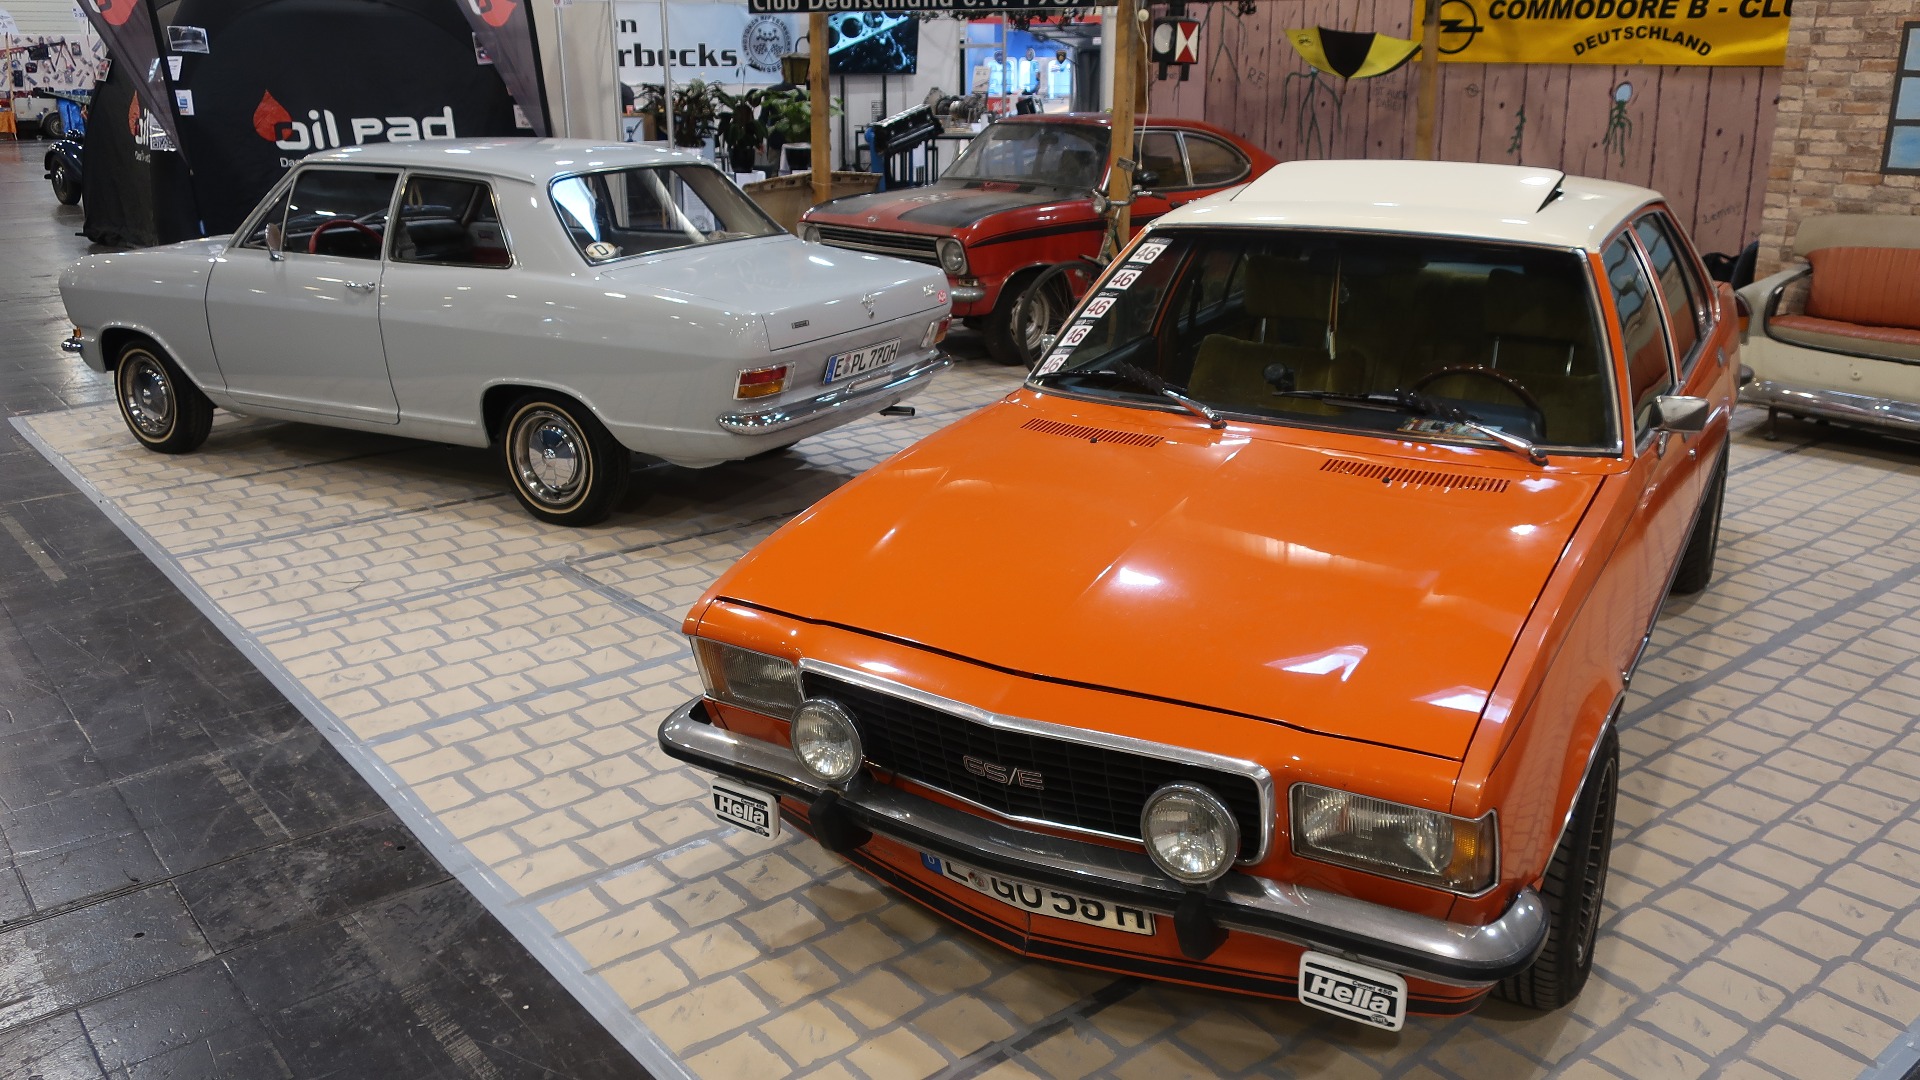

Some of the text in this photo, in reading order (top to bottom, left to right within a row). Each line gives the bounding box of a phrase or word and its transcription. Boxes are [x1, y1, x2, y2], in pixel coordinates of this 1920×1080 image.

[1489, 0, 1679, 19] COMMODORE
[1687, 0, 1708, 18] B
[1573, 25, 1712, 56] DEUTSCHLAND
[274, 105, 456, 150] oil pad
[594, 244, 608, 255] D
[1134, 245, 1162, 261] 46
[1111, 271, 1136, 287] 46
[1086, 299, 1111, 316] 46
[1066, 327, 1087, 344] 46
[834, 343, 898, 377] E PL 770H
[963, 755, 1044, 790] GS/E
[719, 796, 765, 826] Hella
[1310, 975, 1390, 1014] Hella
